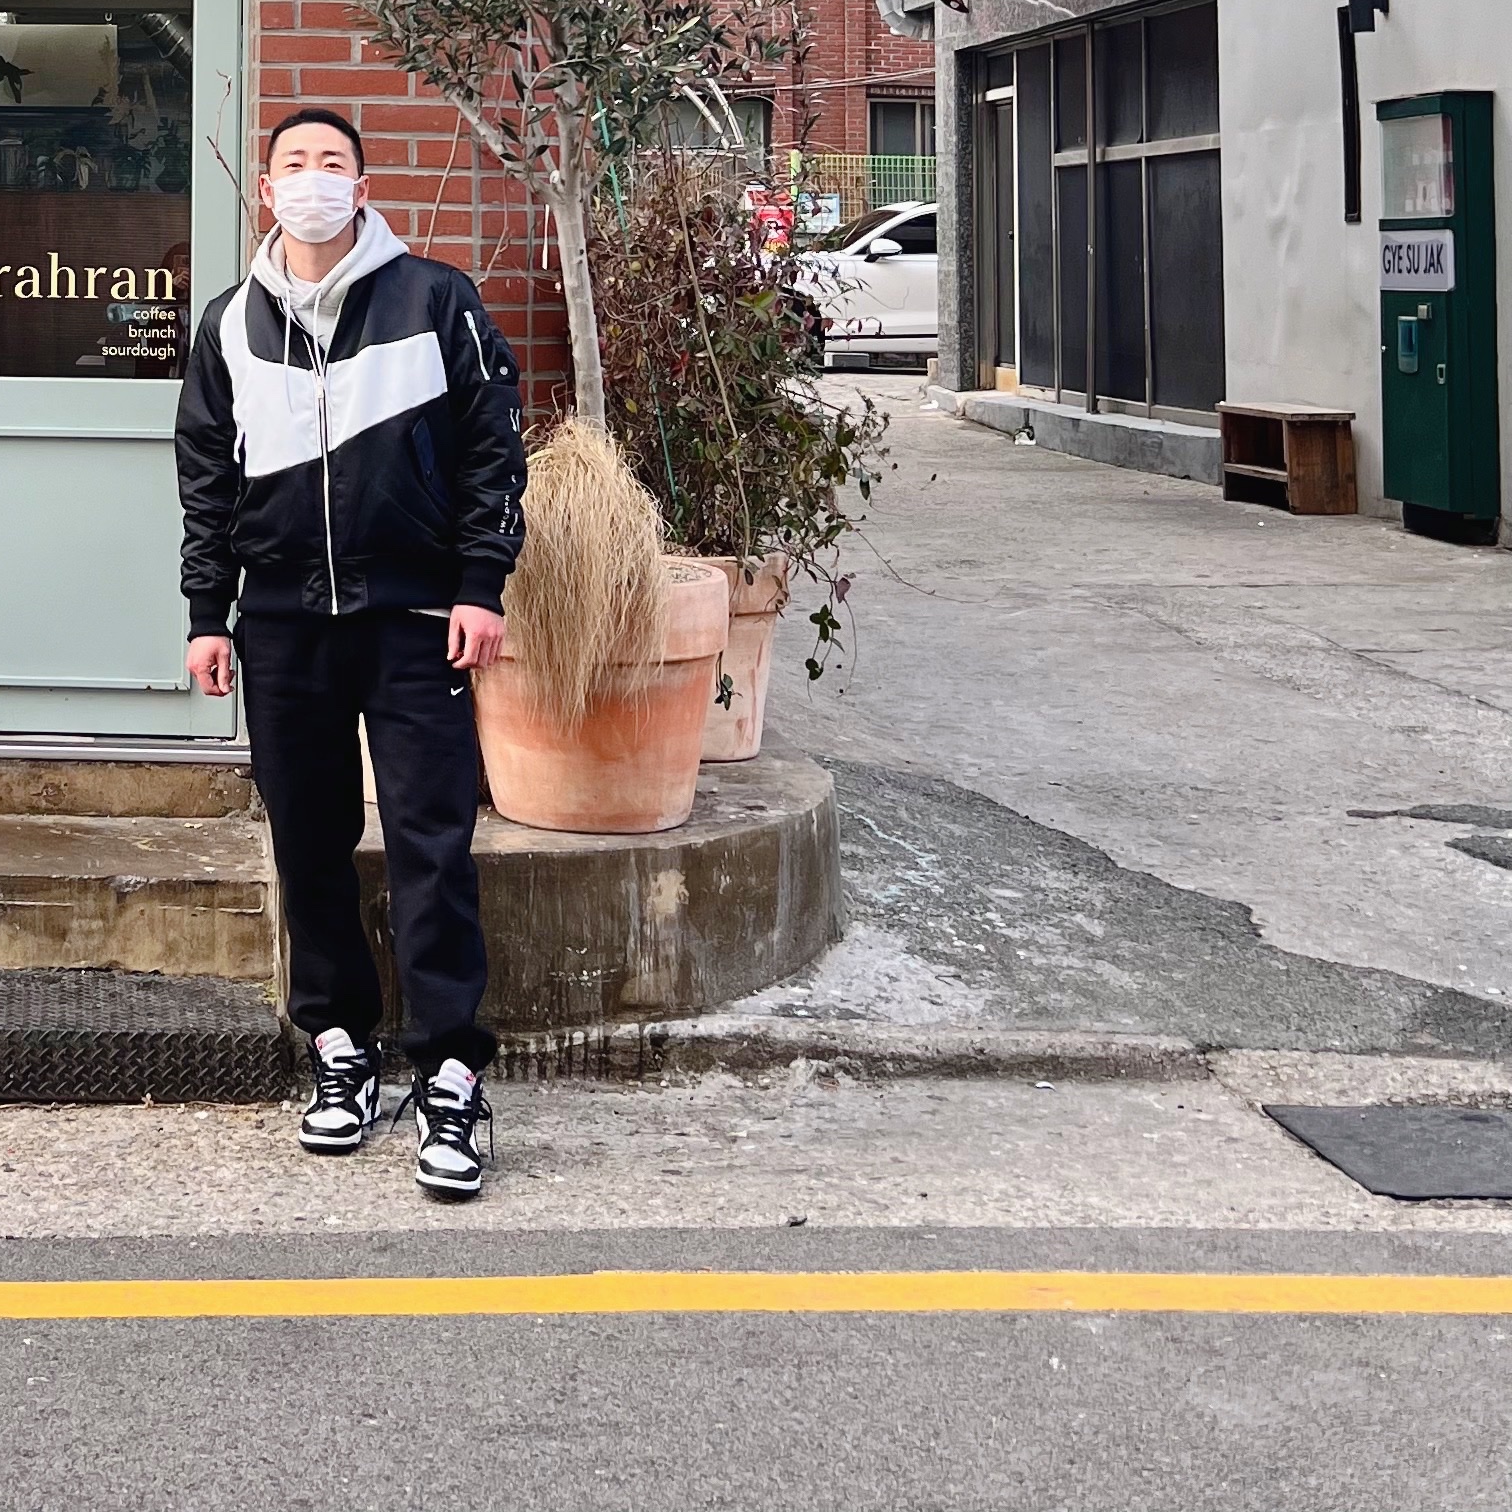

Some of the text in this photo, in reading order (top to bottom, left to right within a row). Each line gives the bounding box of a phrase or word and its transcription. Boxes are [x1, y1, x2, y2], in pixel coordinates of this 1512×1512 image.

[1382, 243, 1444, 275] GYE SU JAK
[133, 306, 176, 320] coffee
[128, 324, 176, 339] brunch
[101, 343, 176, 361] sourdough
